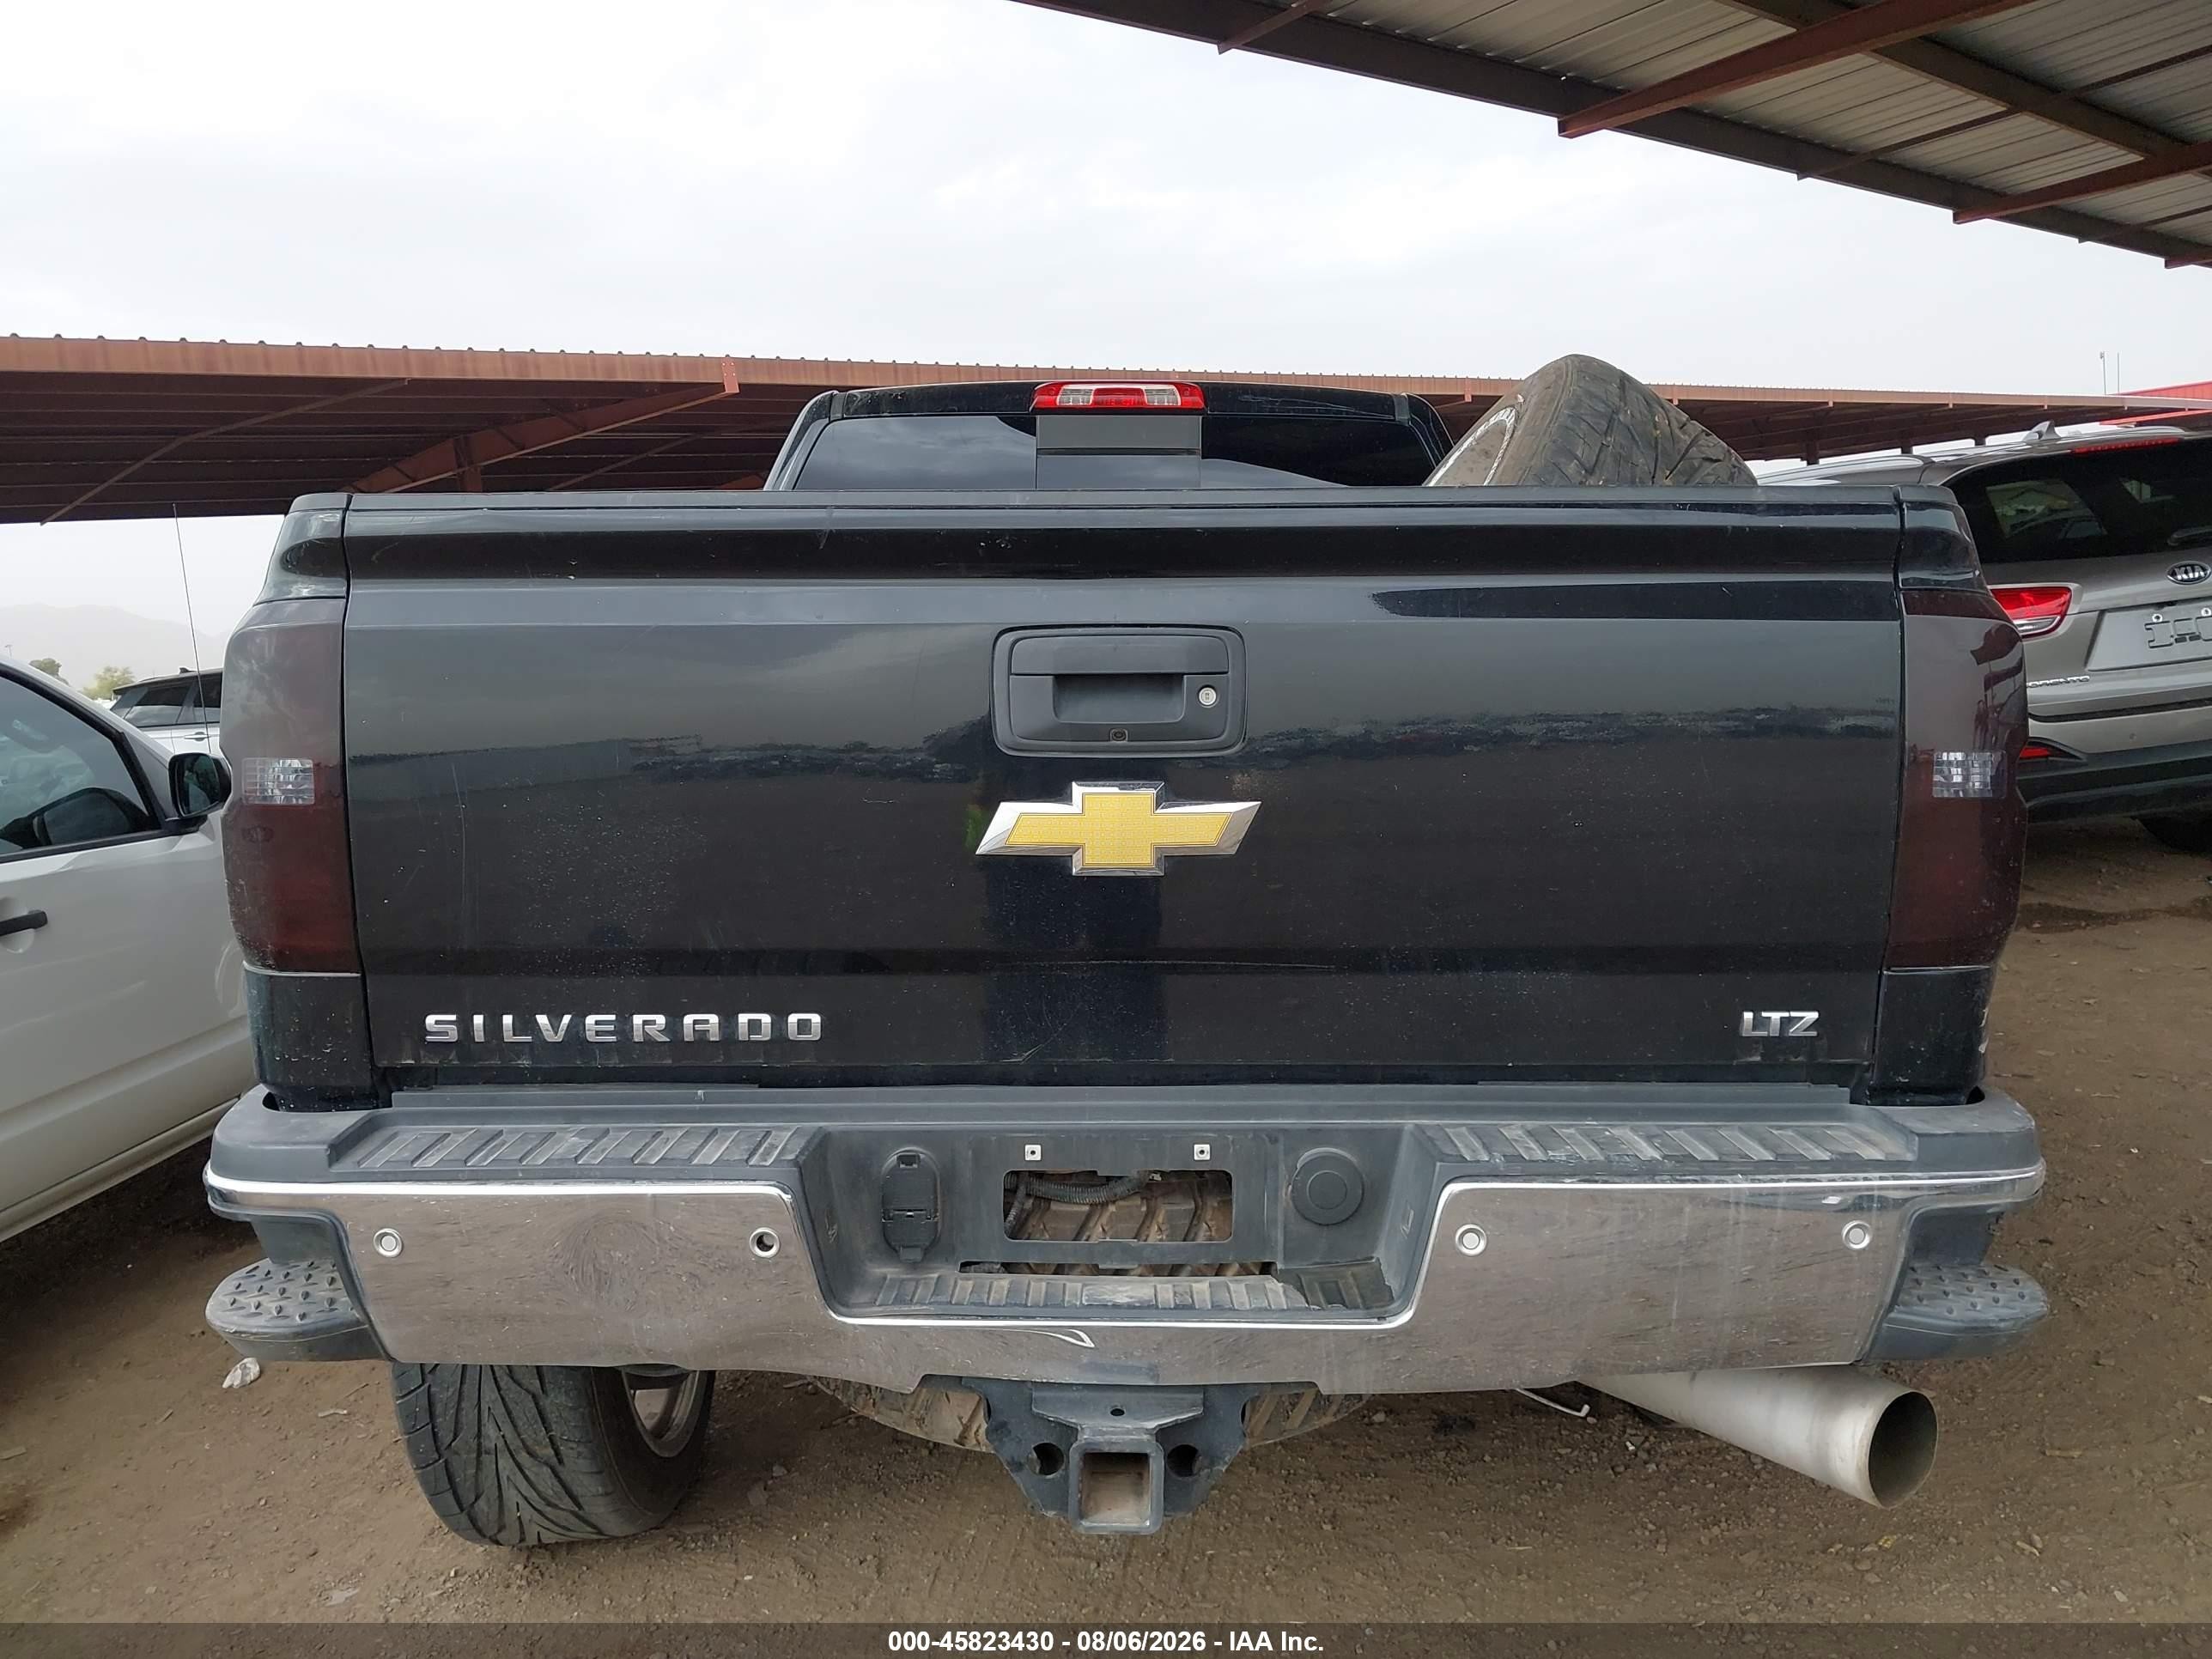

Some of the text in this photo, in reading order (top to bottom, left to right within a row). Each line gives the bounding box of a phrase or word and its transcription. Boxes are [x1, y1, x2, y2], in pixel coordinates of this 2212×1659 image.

[2173, 566, 2206, 580] KIA
[2027, 675, 2090, 688] ORENTO
[424, 1012, 823, 1042] SILVERADO
[1741, 1011, 1819, 1036] LTZ
